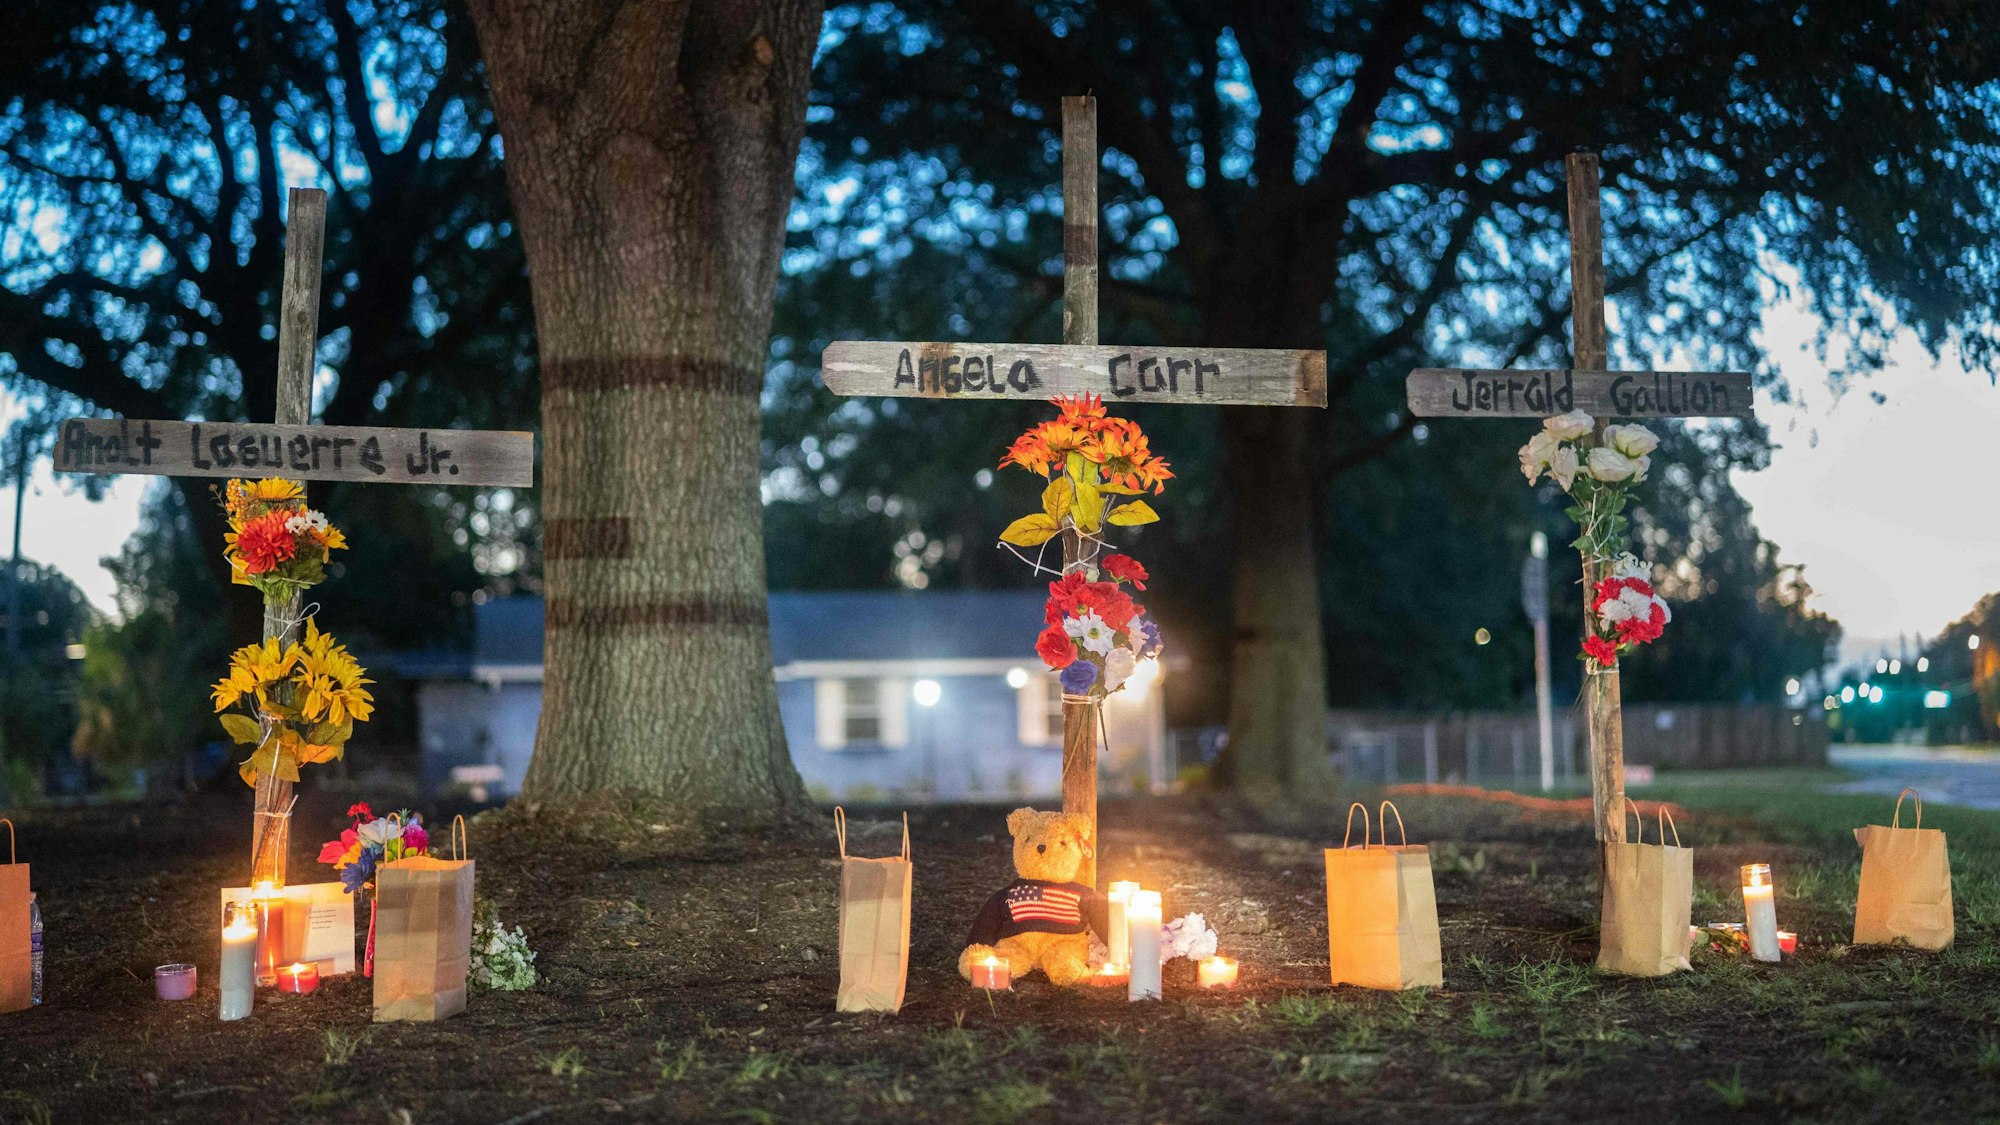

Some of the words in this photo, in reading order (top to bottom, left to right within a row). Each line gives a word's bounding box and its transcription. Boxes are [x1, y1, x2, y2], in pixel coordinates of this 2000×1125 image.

[1108, 353, 1220, 397] Carr
[1452, 370, 1574, 412] Jerrald
[1610, 371, 1731, 415] Gallion
[406, 431, 459, 476] Jr.
